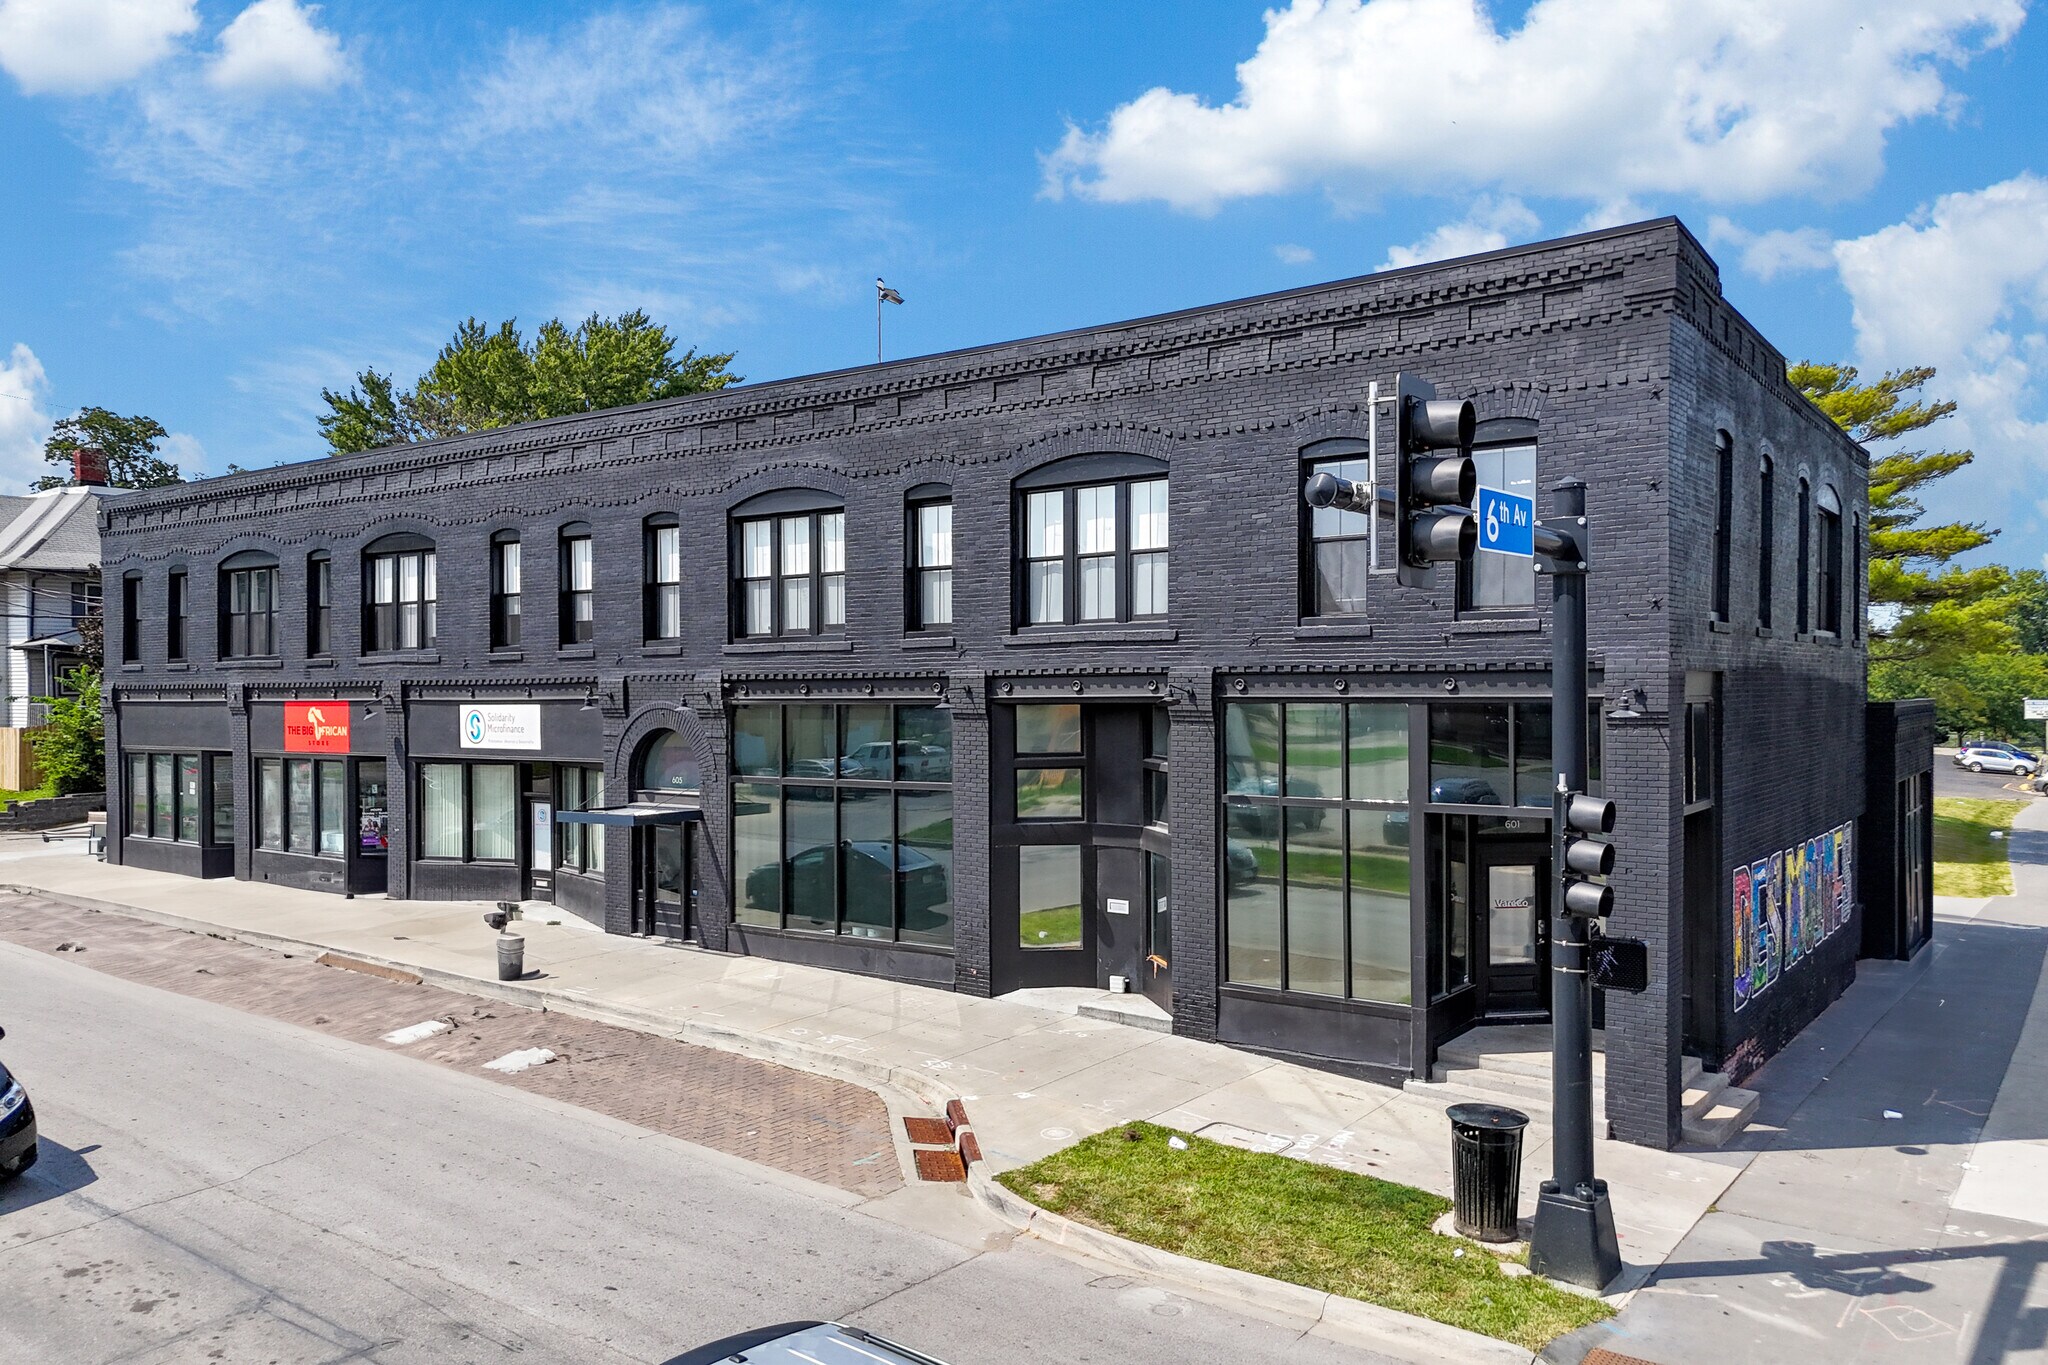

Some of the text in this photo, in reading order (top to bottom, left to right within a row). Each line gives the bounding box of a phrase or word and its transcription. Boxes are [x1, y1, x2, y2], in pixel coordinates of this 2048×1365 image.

[1486, 498, 1527, 543] 6th Av
[487, 712, 516, 725] Solidarity
[287, 725, 301, 736] THE
[302, 725, 314, 736] BIG
[487, 724, 525, 734] Microfinance
[671, 776, 683, 784] 605
[1504, 820, 1521, 829] 601
[1733, 820, 1853, 1012] DES MOINES
